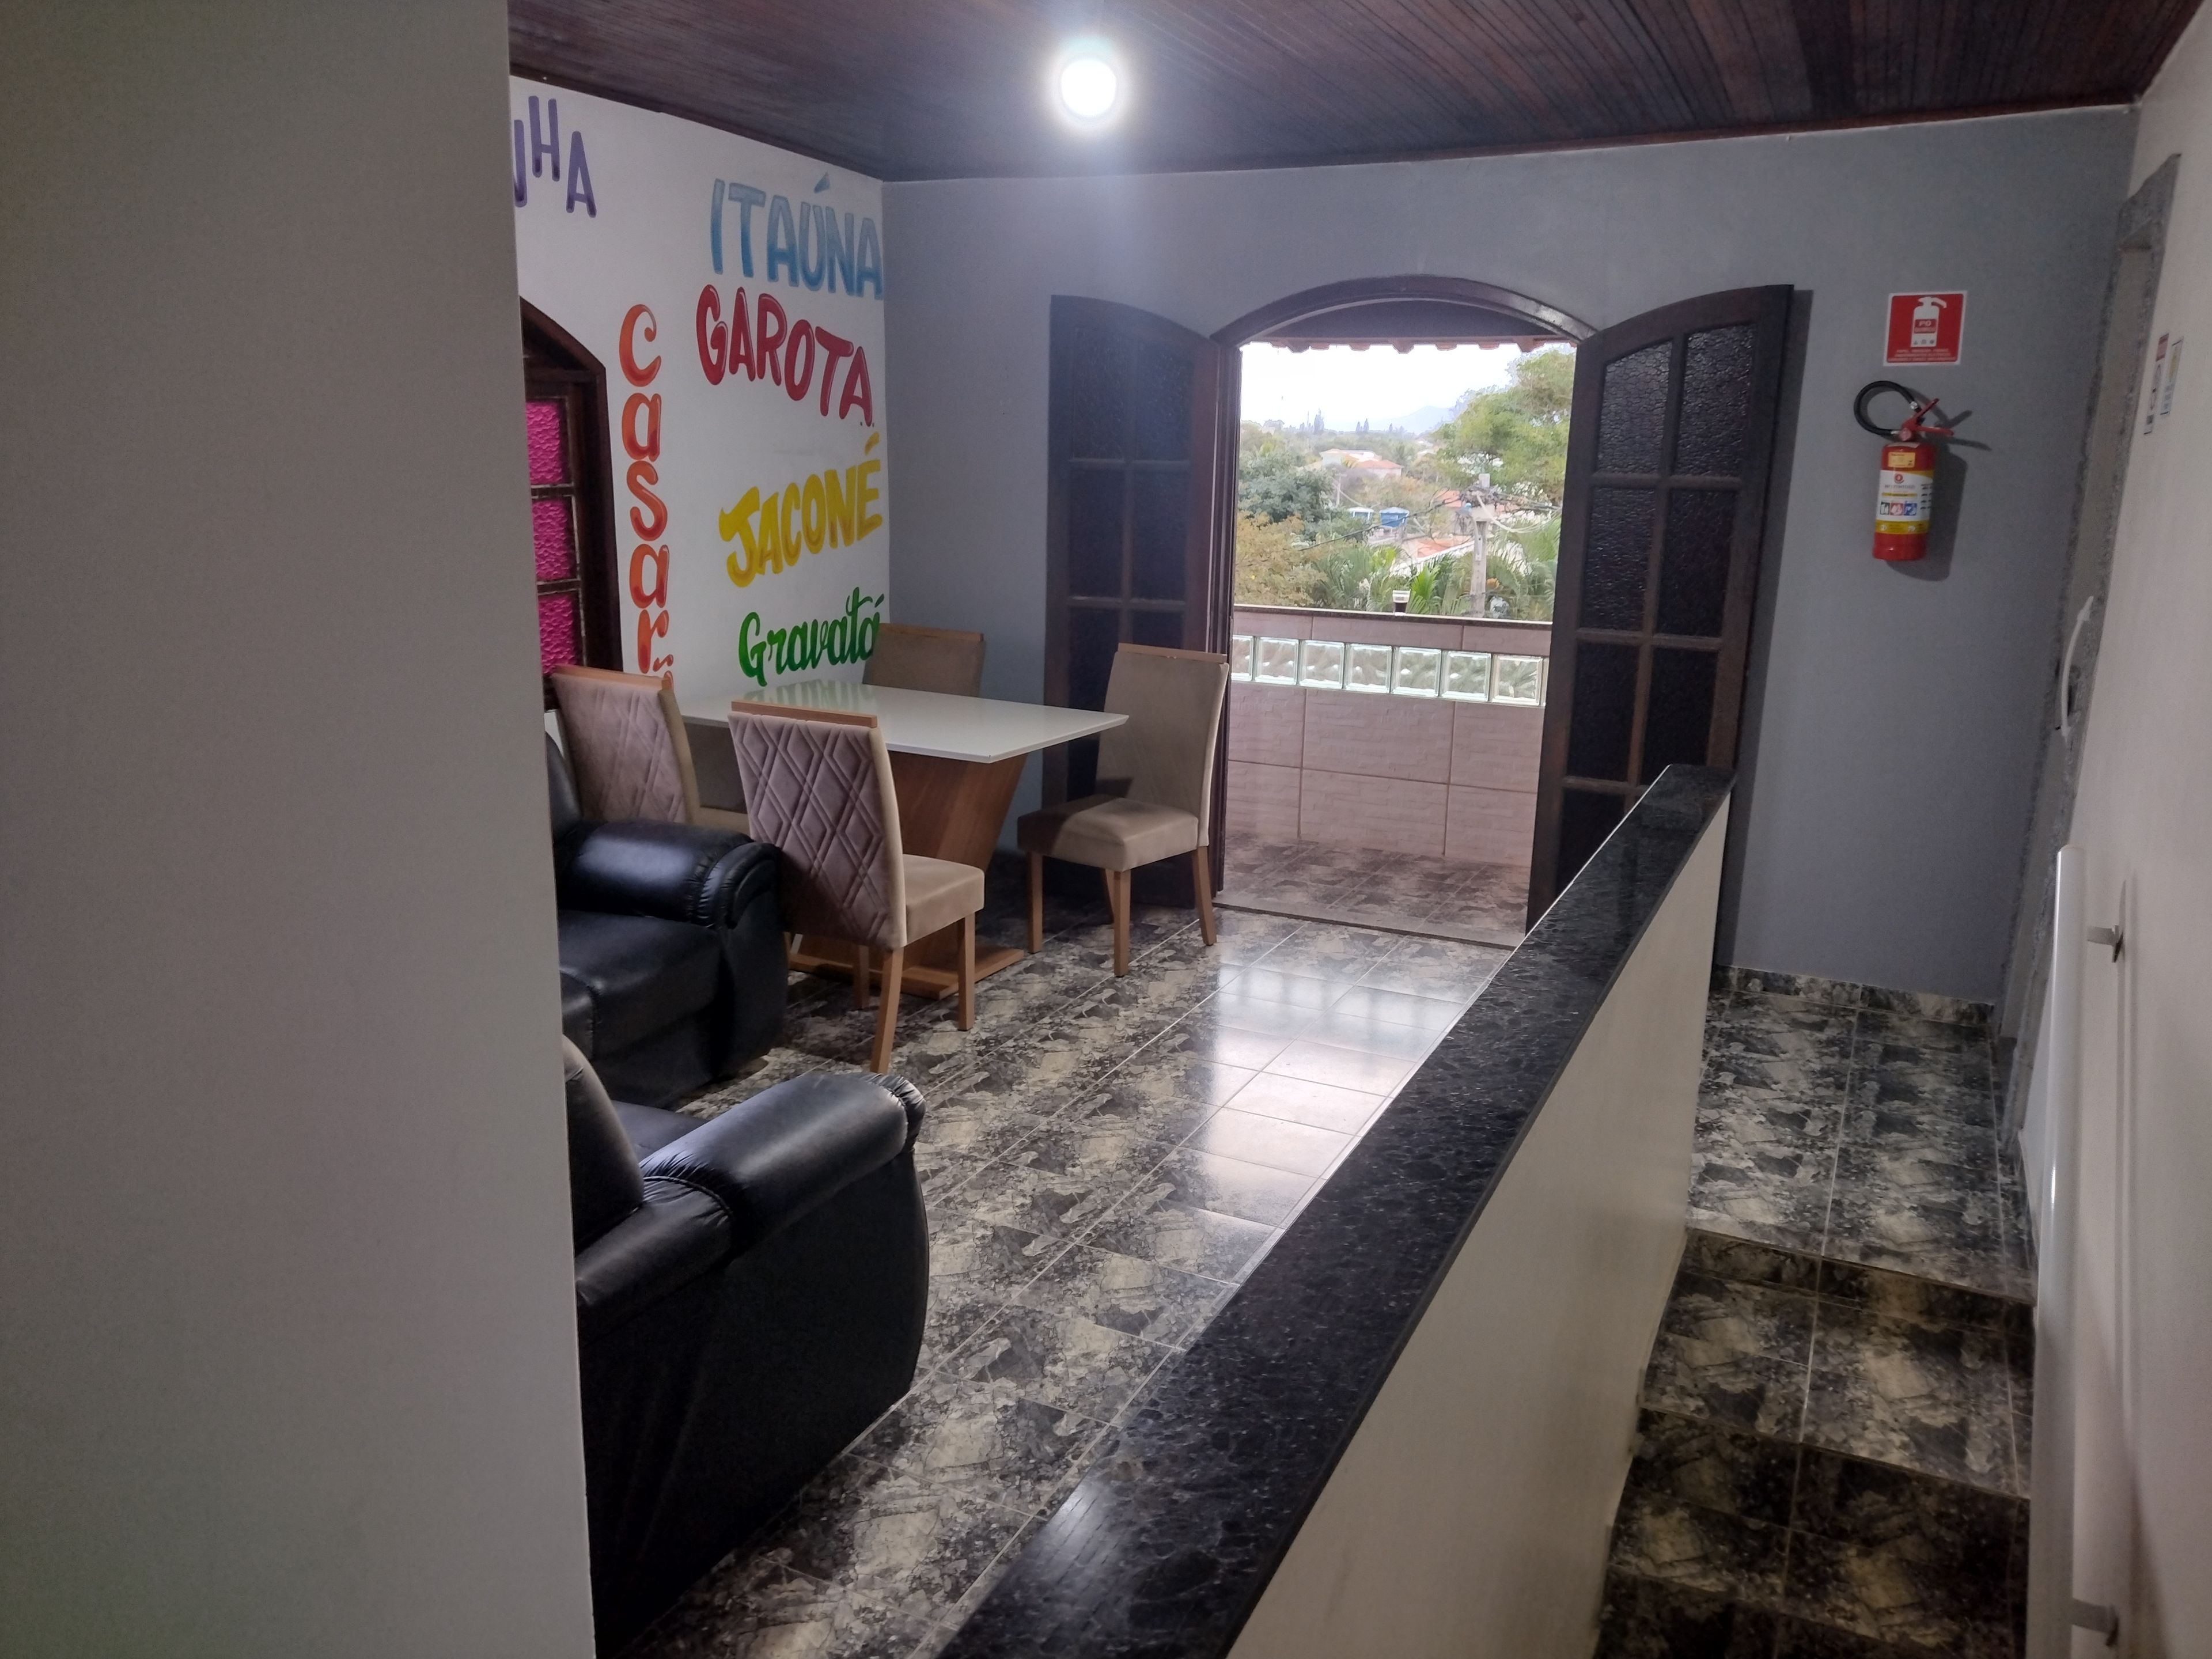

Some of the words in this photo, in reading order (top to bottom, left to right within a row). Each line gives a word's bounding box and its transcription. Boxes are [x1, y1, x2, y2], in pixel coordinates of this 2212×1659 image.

[710, 173, 884, 300] ITAÚNA
[696, 284, 873, 426] GAROTA
[718, 432, 883, 588] JACONÉ
[738, 587, 885, 687] Gravatá
